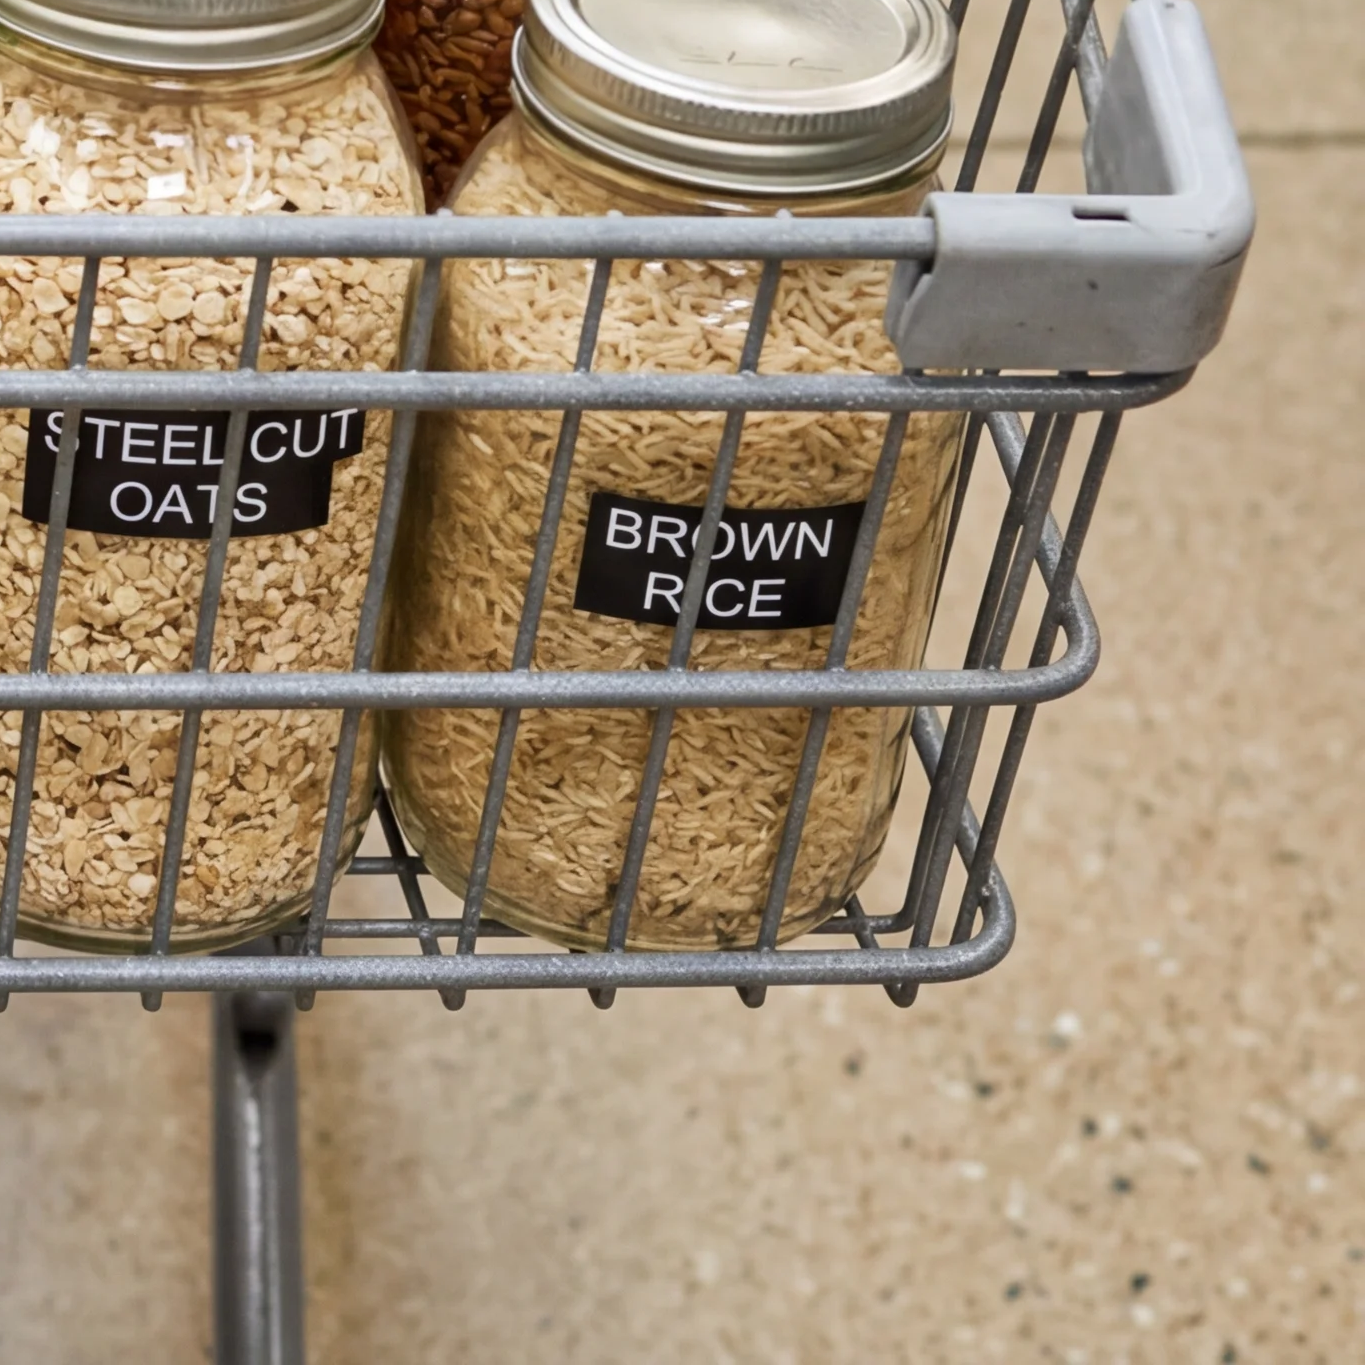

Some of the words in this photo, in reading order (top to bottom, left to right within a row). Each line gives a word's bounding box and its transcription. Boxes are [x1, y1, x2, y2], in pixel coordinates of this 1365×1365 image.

[249, 408, 359, 464] CUT
[109, 481, 269, 525] OATS
[605, 506, 834, 562] BROWN
[643, 571, 786, 618] RCE
